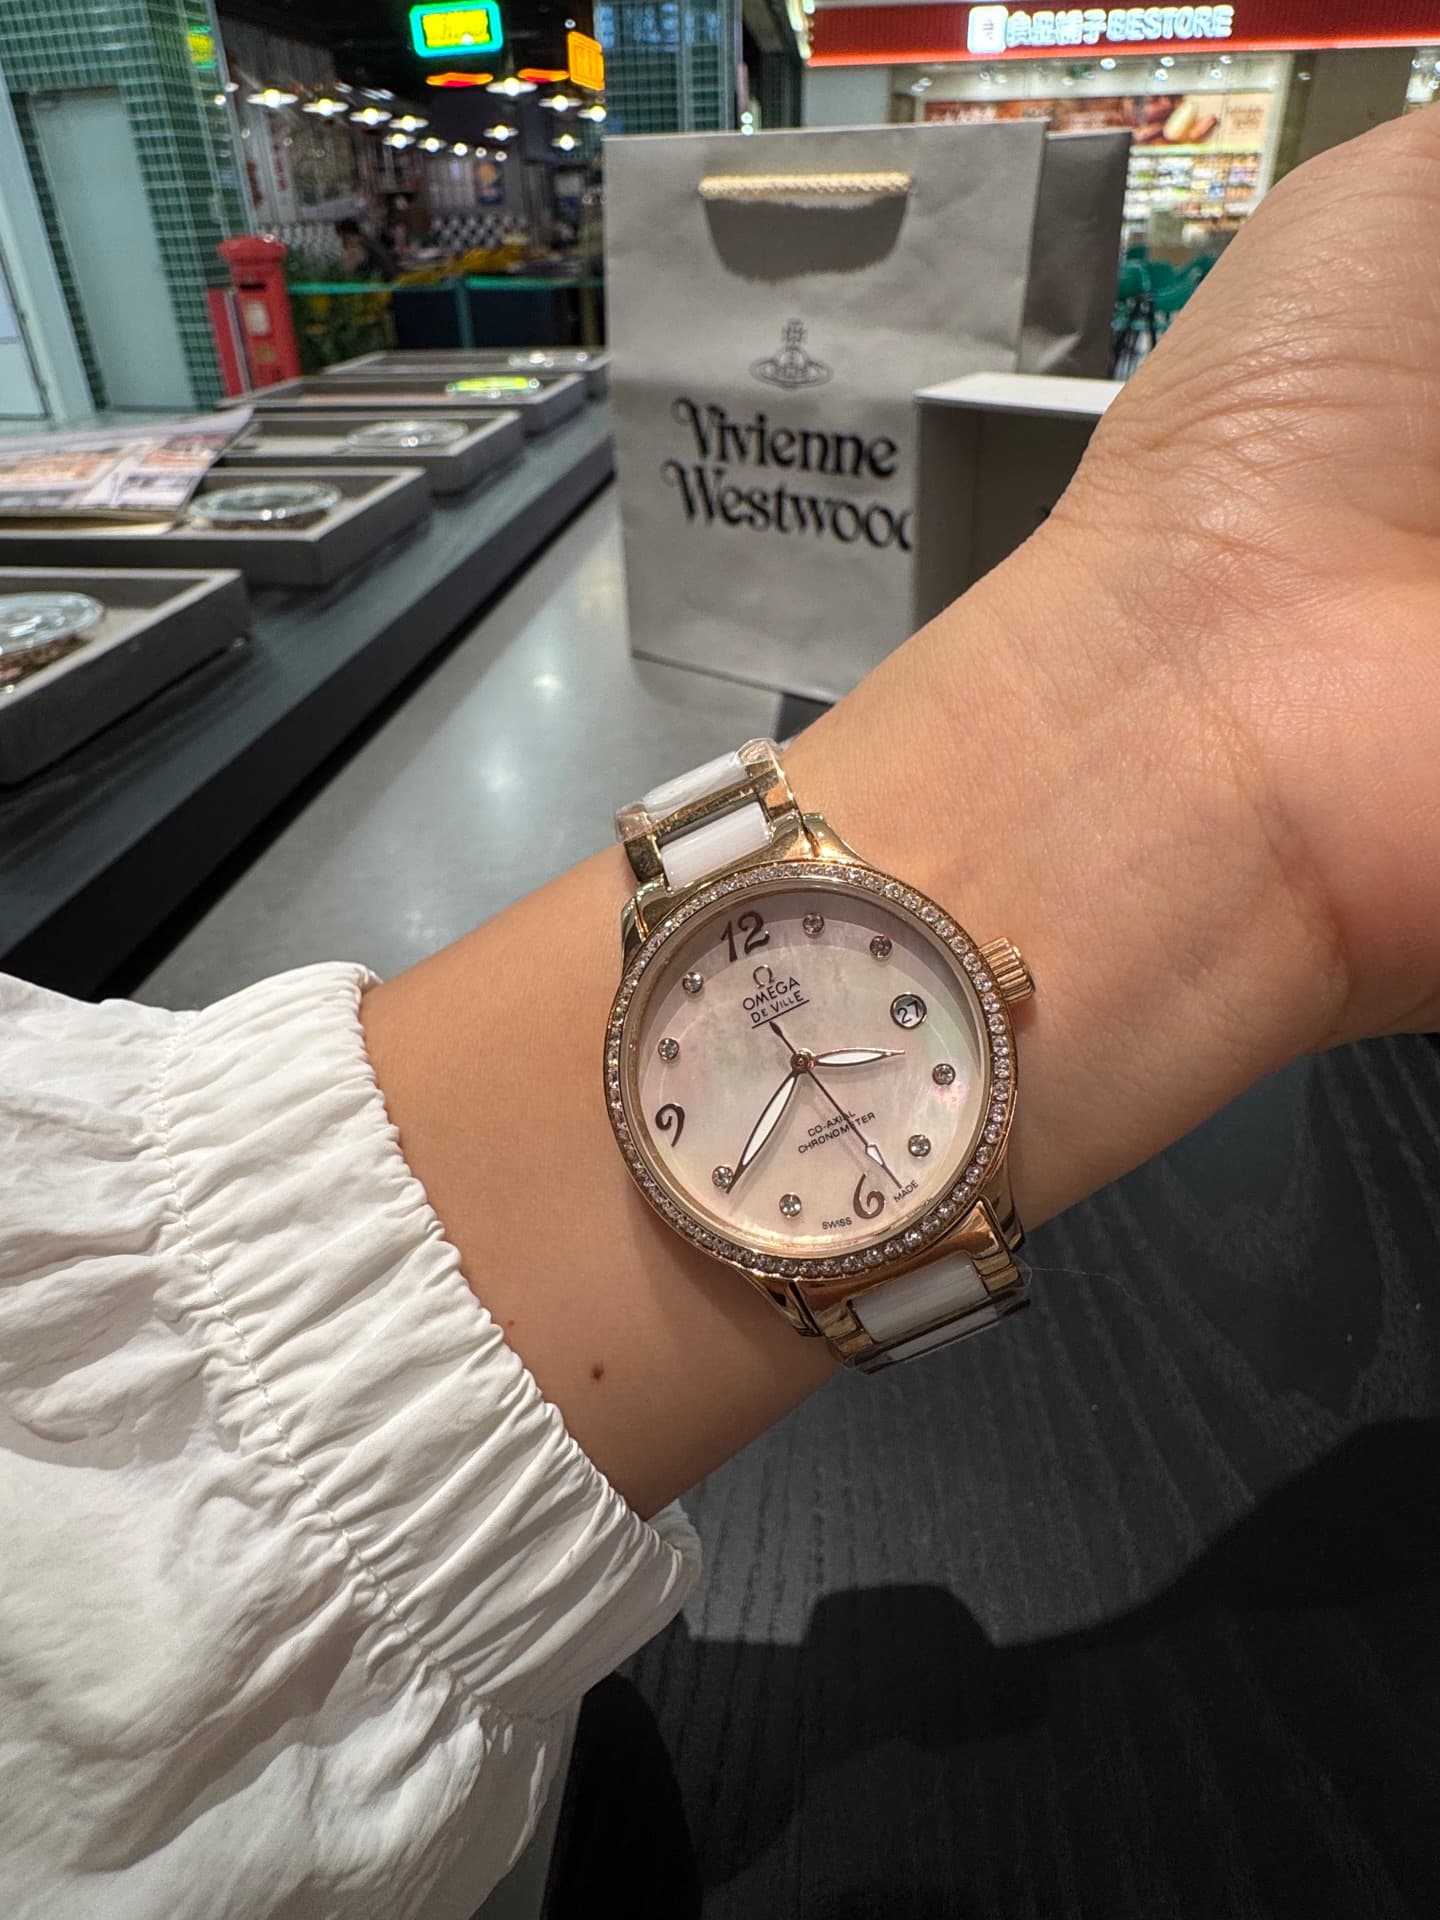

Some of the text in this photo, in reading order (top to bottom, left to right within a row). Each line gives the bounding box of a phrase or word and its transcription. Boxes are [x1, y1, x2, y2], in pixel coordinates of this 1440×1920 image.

[1106, 5, 1234, 41] BESTORE
[671, 397, 897, 479] Vivienne
[721, 911, 770, 962] 12
[742, 976, 801, 1011] OMEGA
[896, 1000, 920, 1024] 27
[751, 1008, 769, 1024] DE
[655, 1103, 686, 1148] 9
[798, 1112, 876, 1155] CHRONOMETER
[807, 1111, 857, 1138] CO-AXIAL
[821, 1179, 920, 1231] SWISS MADE
[853, 1172, 885, 1220] 6
